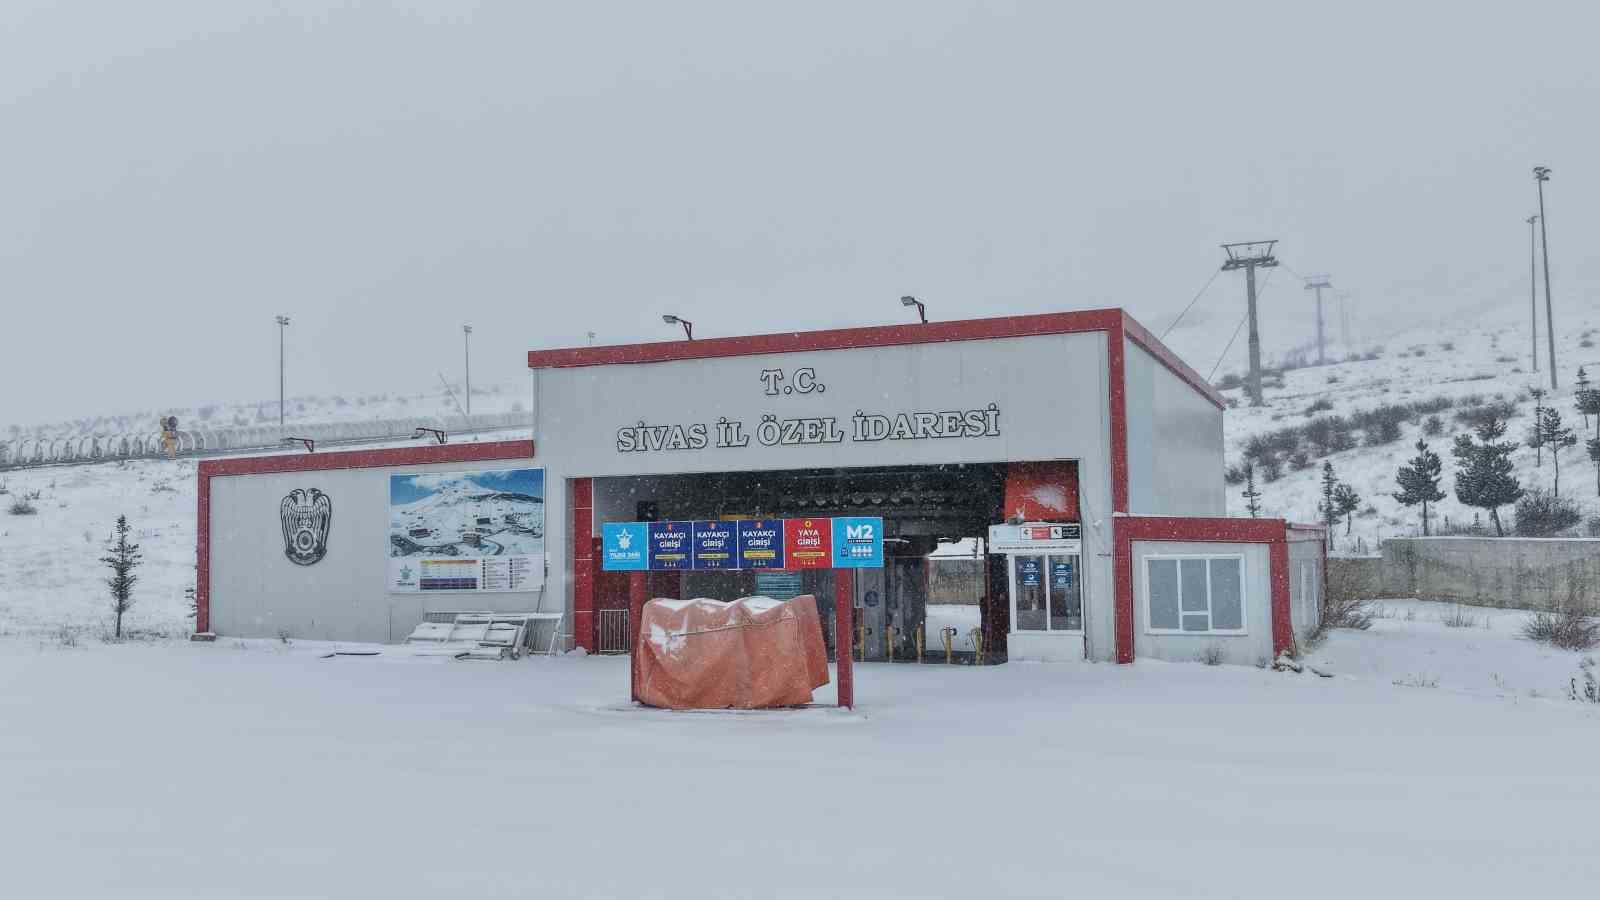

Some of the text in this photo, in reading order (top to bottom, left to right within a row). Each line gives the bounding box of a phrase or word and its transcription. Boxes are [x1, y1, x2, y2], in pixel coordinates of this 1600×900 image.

[760, 368, 826, 396] T.C.
[617, 403, 1000, 452] SİVAS İL ÖZEL İDARESİ
[654, 532, 686, 540] KAYAKÇI
[697, 531, 729, 539] KAYAKÇI
[742, 530, 776, 539] KAYAKÇI
[798, 529, 819, 537] YAYA
[846, 525, 873, 539] M2
[659, 539, 681, 549] GİRİŞİ
[702, 539, 724, 548] GİRİŞİ
[747, 538, 771, 547] GİRİŞİ
[797, 537, 820, 546] GİRİŞİ
